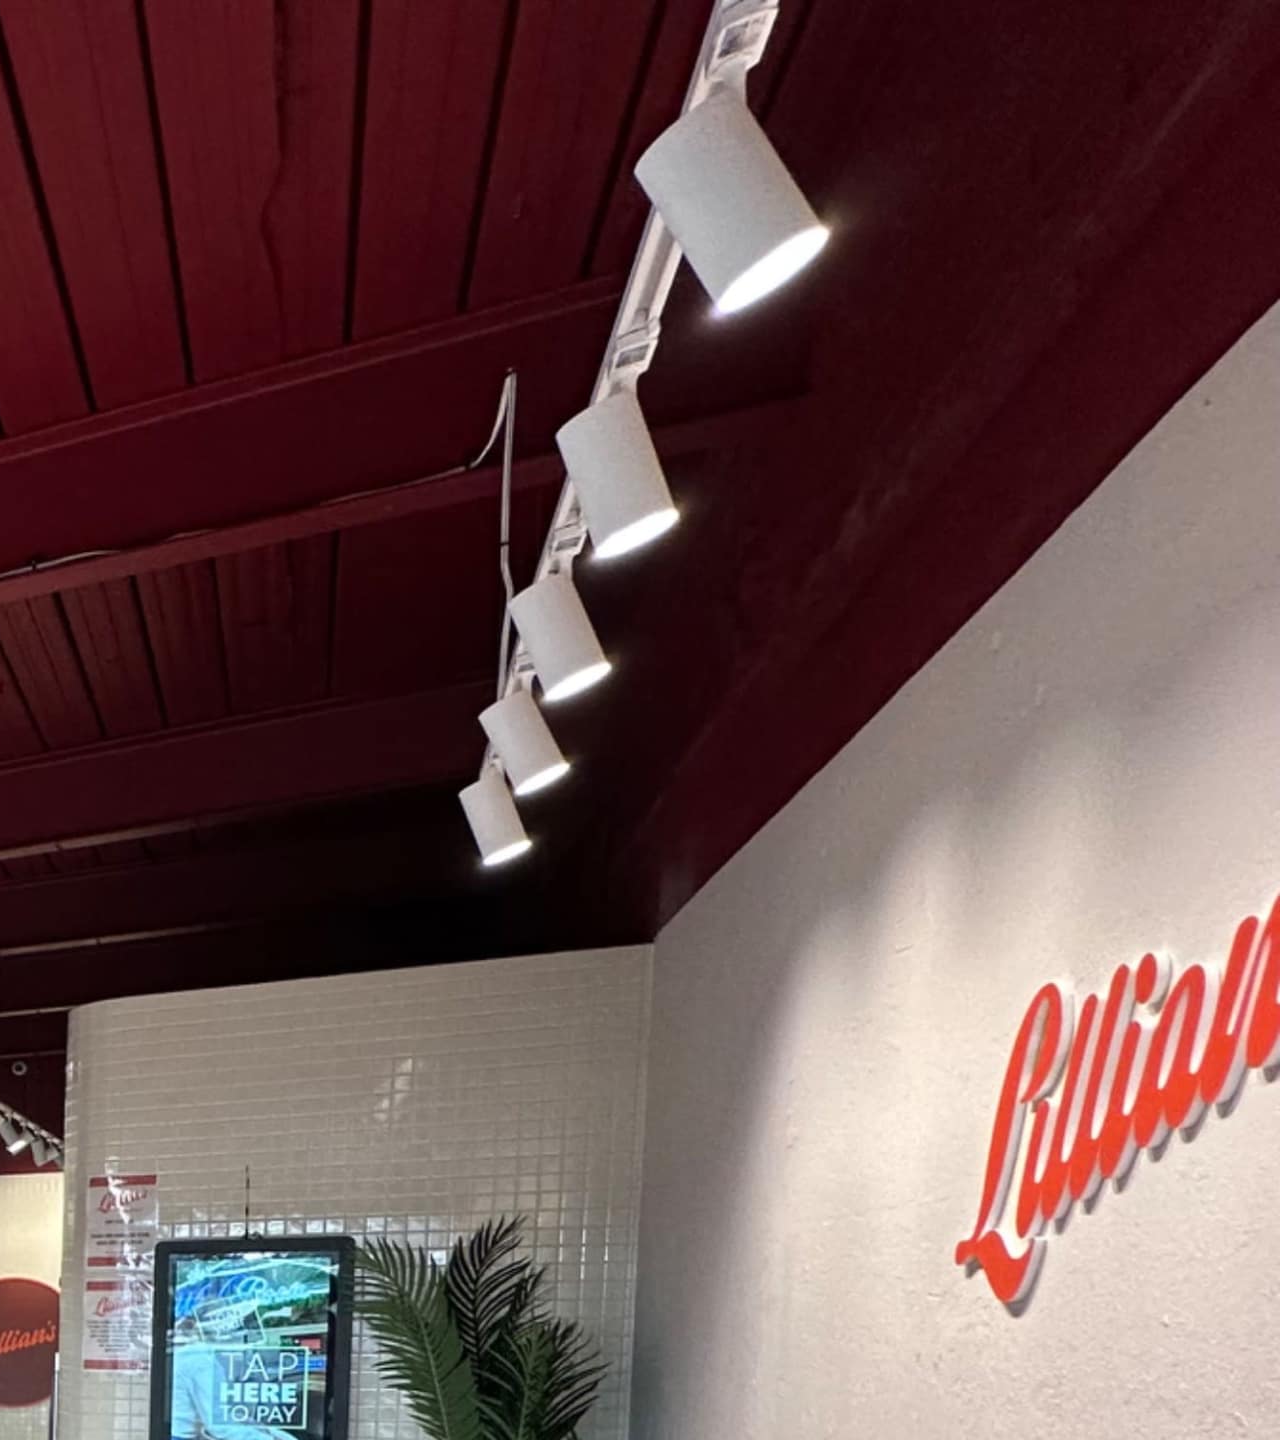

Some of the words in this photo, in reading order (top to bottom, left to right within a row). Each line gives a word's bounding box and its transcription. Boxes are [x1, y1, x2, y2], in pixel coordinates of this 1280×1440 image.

[221, 1351, 299, 1382] TAP
[221, 1382, 298, 1404] HERE
[220, 1404, 250, 1423] TO
[256, 1405, 298, 1424] PAY
